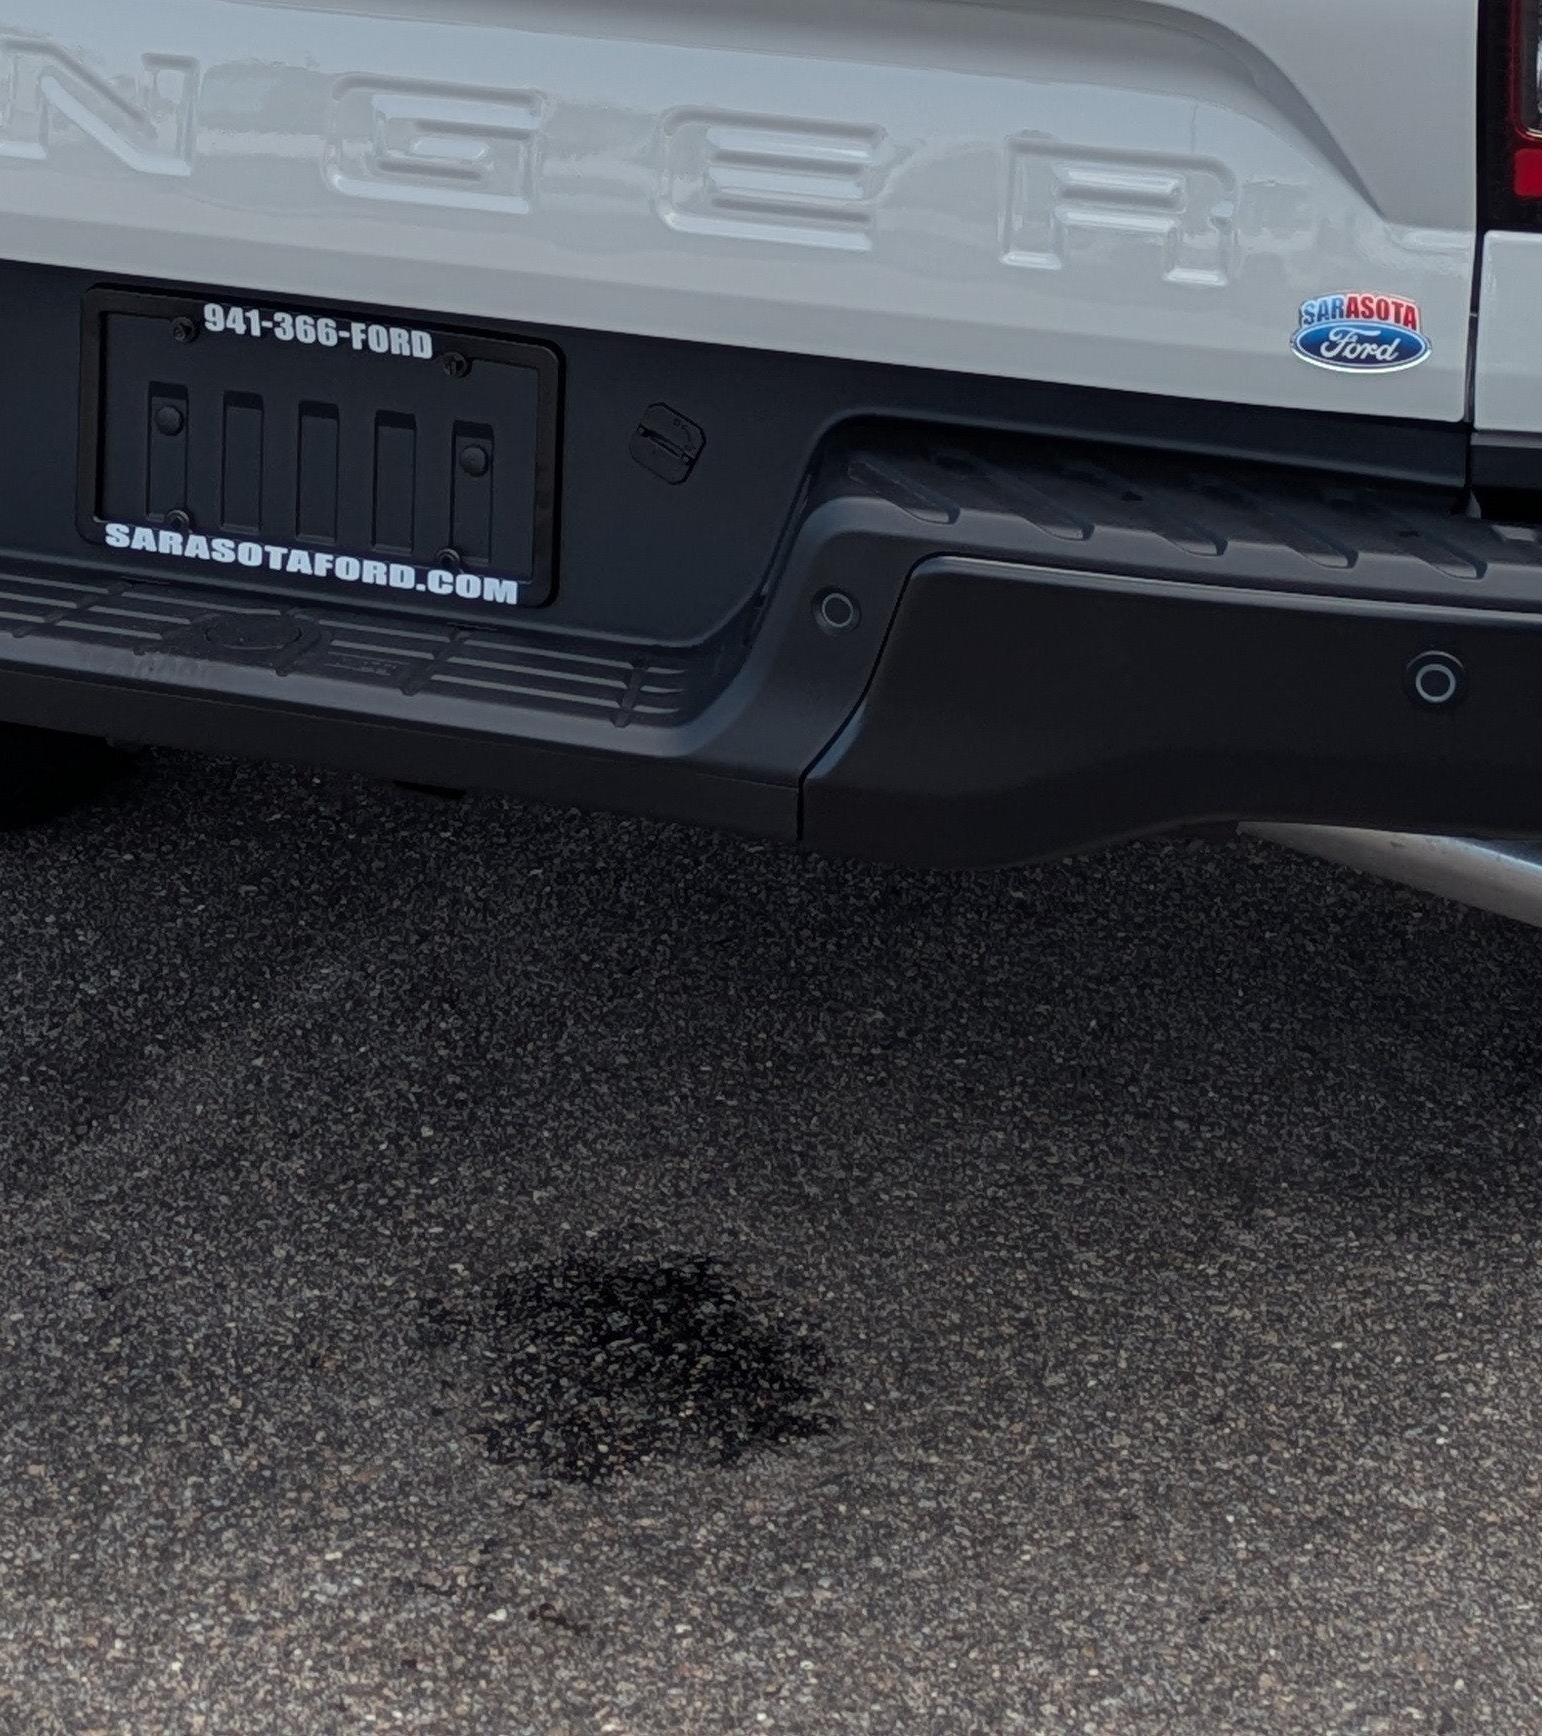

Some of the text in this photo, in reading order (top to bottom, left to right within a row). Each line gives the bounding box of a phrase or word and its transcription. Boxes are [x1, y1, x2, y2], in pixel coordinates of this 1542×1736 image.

[203, 303, 433, 360] 941-366-FORD
[1302, 295, 1417, 331] SARASOTA
[1320, 327, 1402, 362] Ford
[104, 522, 519, 605] SARASOTAFORD.COM
